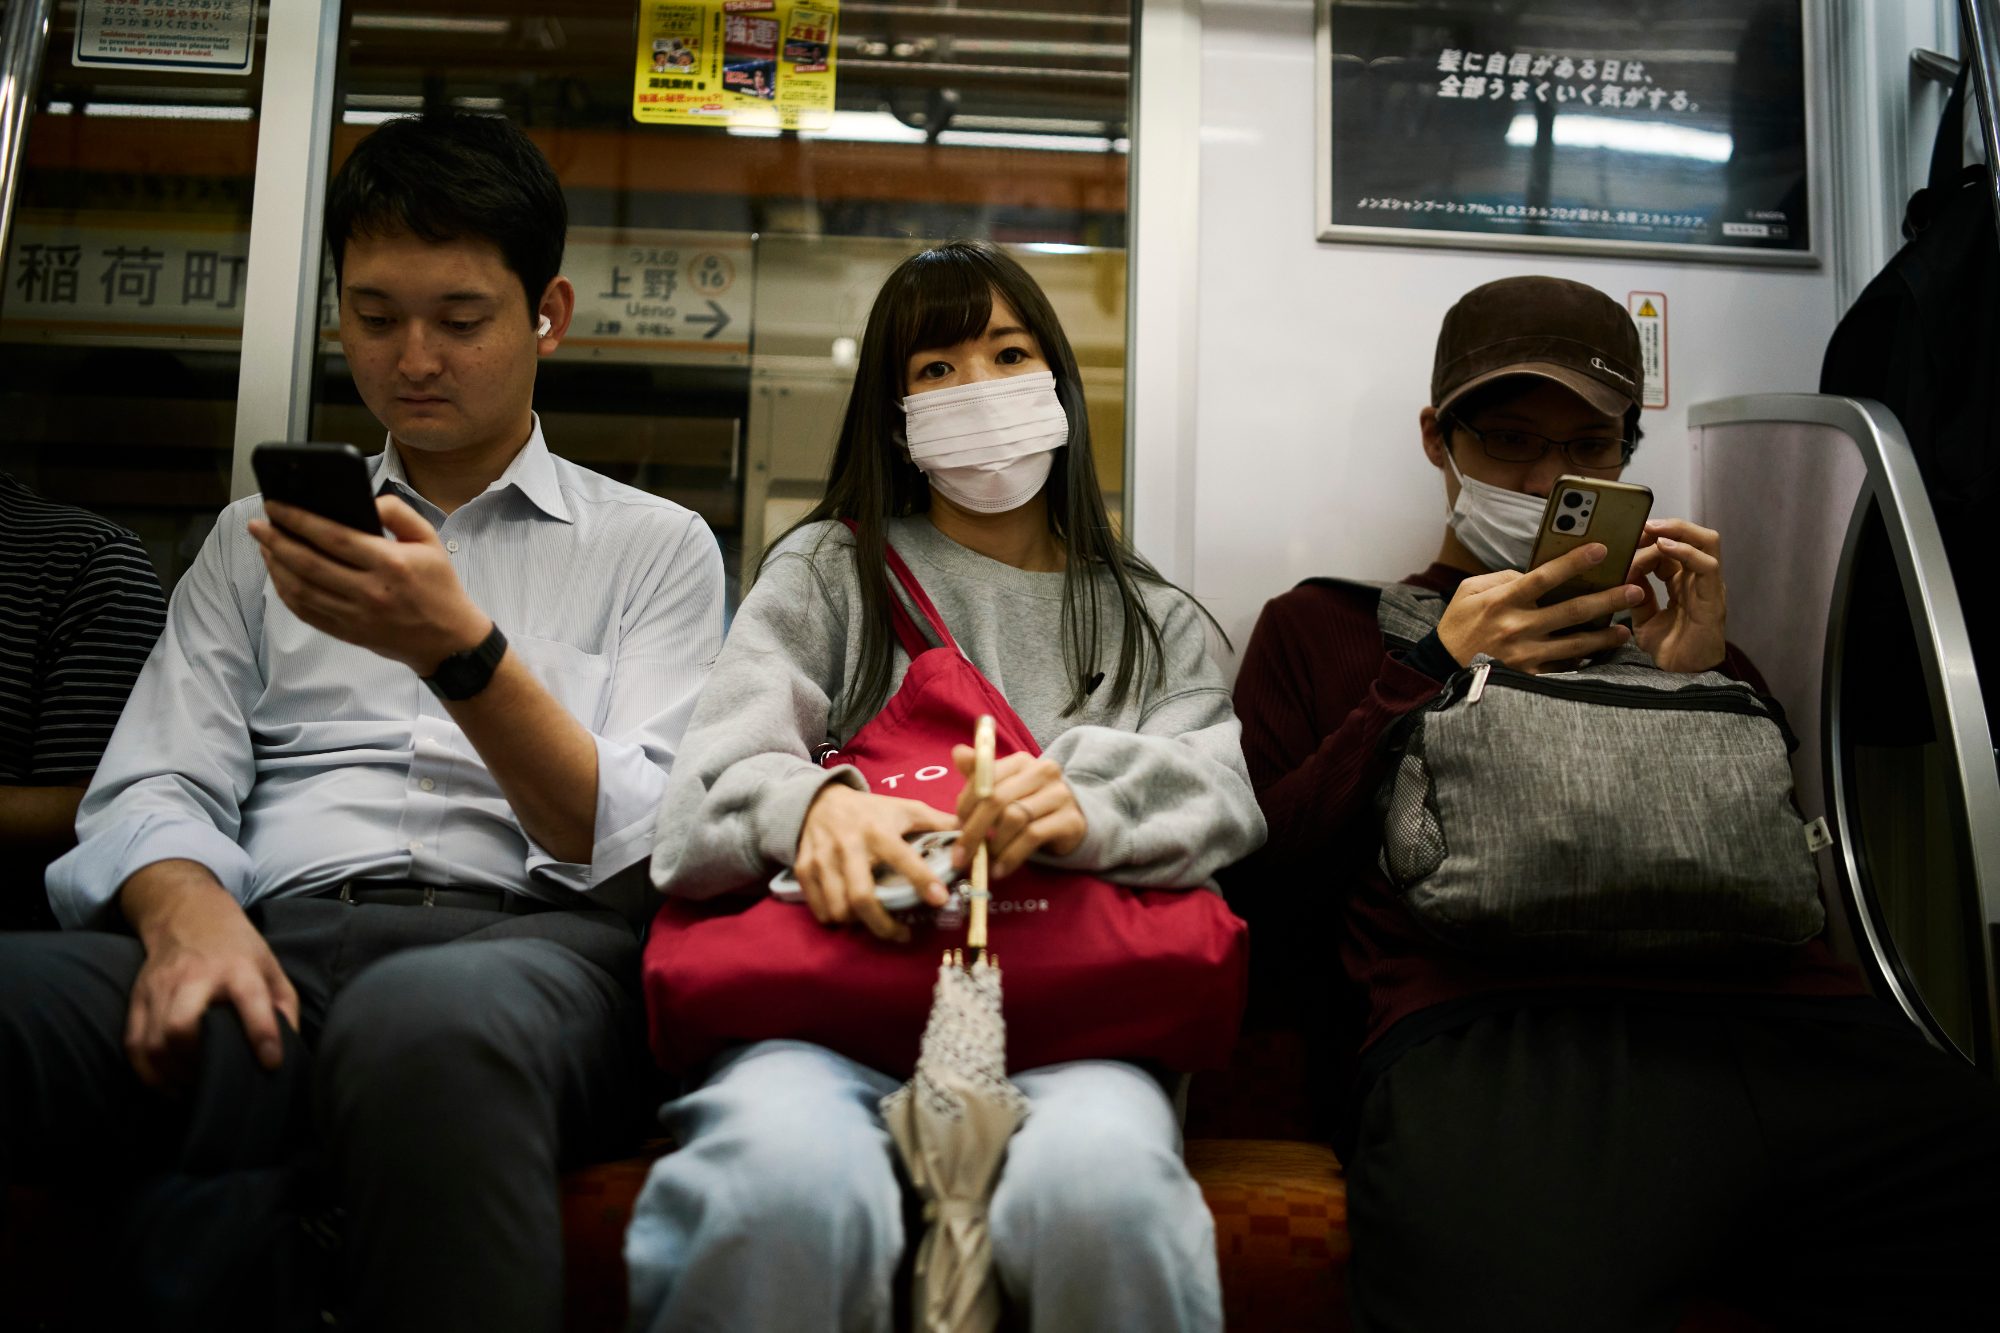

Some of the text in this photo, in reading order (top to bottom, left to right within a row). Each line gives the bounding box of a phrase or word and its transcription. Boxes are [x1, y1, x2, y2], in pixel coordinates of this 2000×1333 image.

[102, 17, 219, 31] おつかまりください。
[726, 14, 775, 48] 強運
[124, 47, 152, 55] hanging
[1437, 48, 1653, 84] 髪に自信がある日は、
[1437, 74, 1699, 112] 全部うまくいく気がする。
[17, 243, 247, 309] 稲荷町
[599, 265, 679, 301] 上野
[701, 271, 725, 288] 16
[626, 302, 677, 318] Ueno
[989, 899, 1049, 914] COLOR
